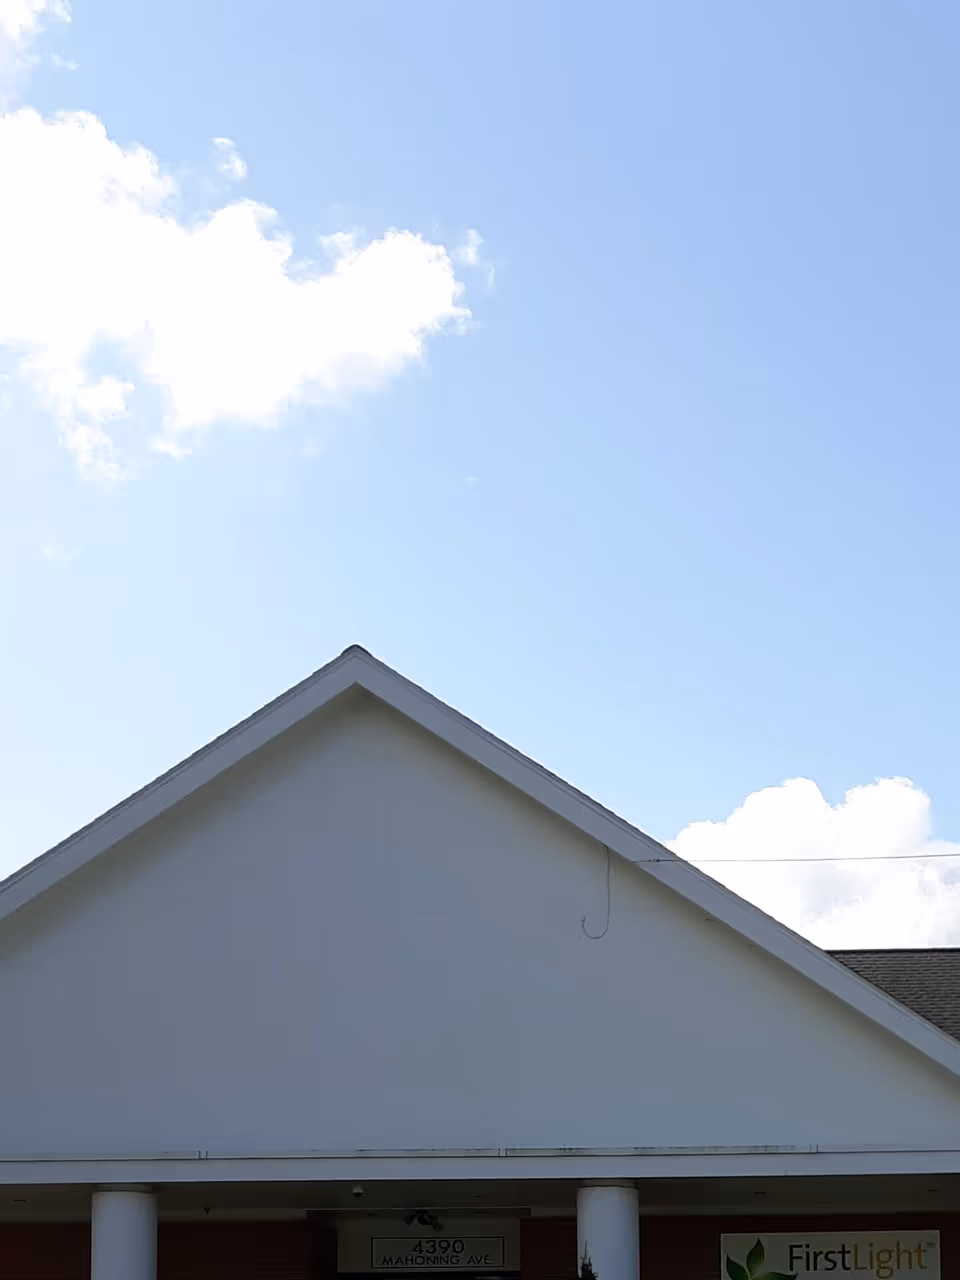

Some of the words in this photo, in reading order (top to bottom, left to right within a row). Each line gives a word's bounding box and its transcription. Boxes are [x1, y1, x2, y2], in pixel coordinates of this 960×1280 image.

[412, 1239, 465, 1254] 4390
[381, 1255, 460, 1266] MAHONING
[467, 1255, 491, 1265] AVE
[788, 1241, 928, 1280] FirstLight
